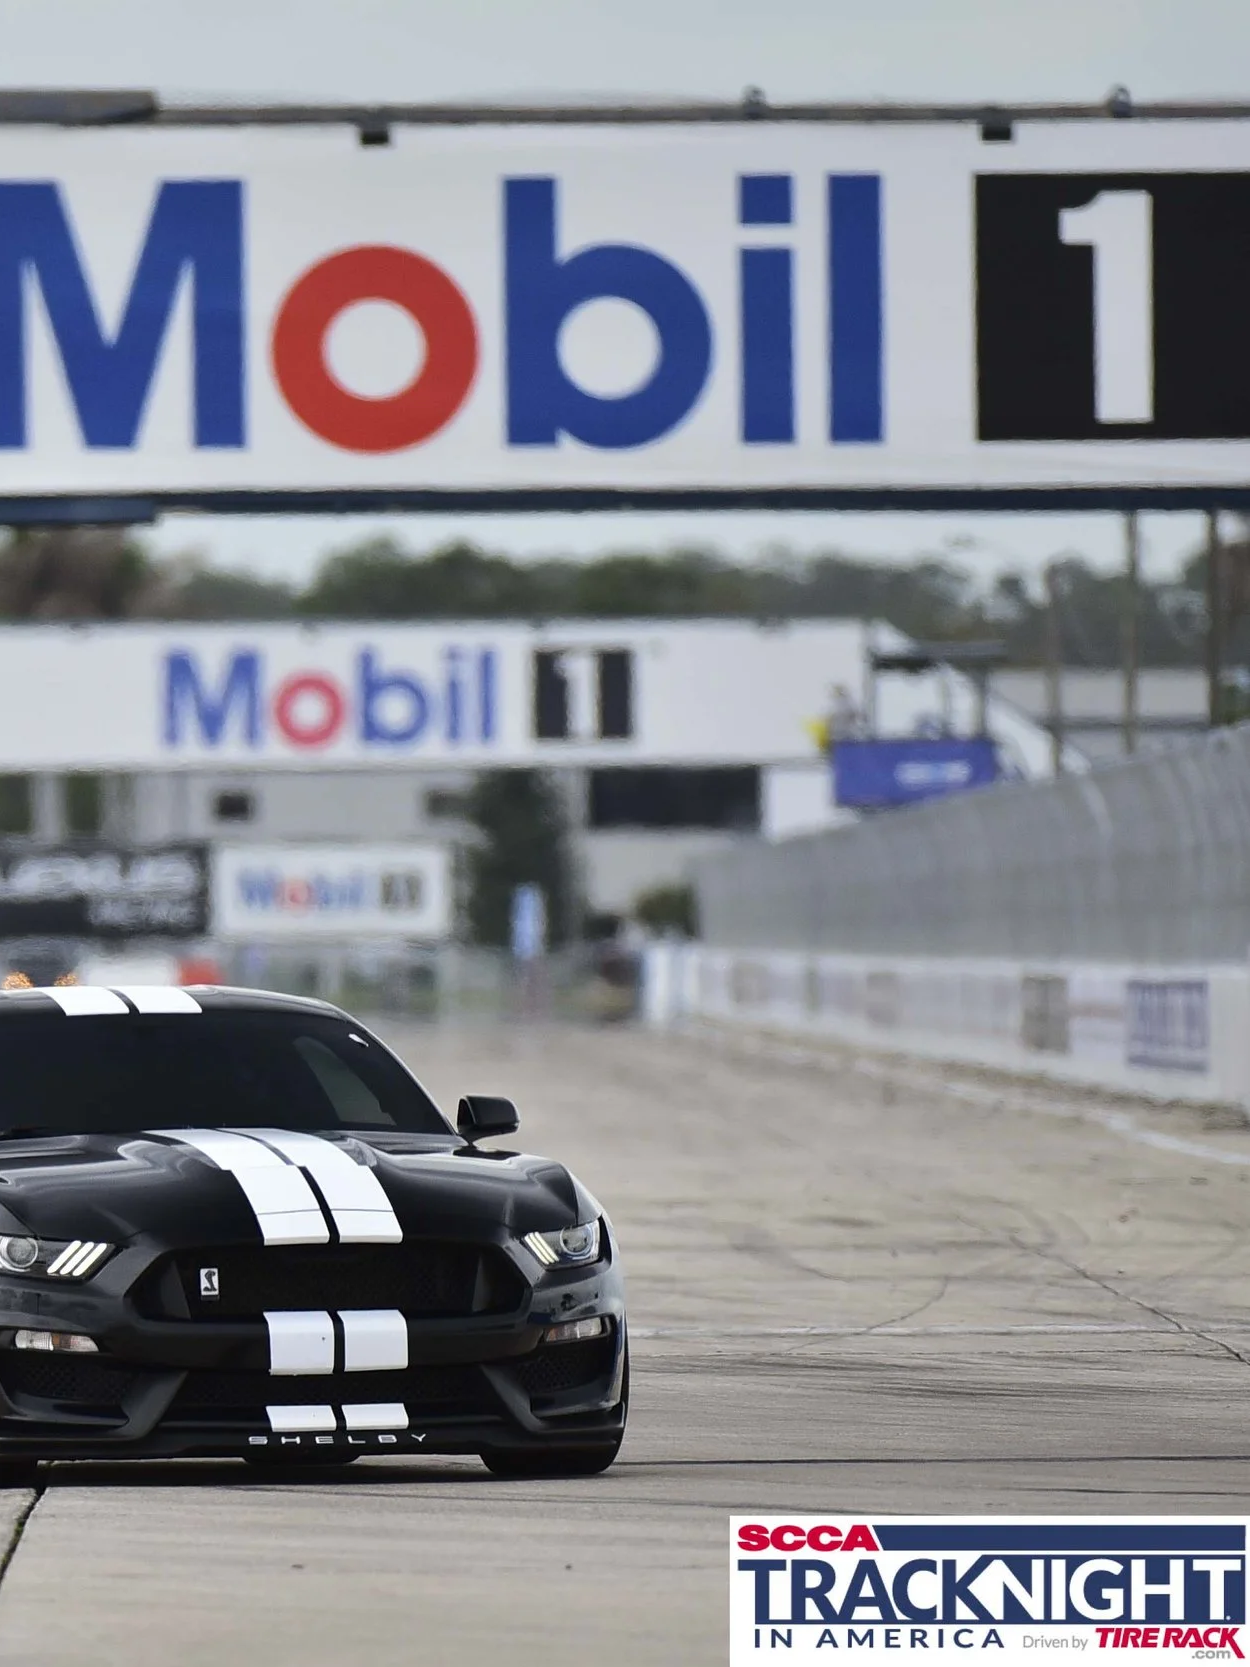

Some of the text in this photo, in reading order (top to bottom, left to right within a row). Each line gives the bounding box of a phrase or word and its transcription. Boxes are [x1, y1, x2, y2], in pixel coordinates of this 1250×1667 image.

[1058, 189, 1154, 424] 1
[164, 646, 600, 749] Mobil 1
[249, 1433, 426, 1445] SHELBY
